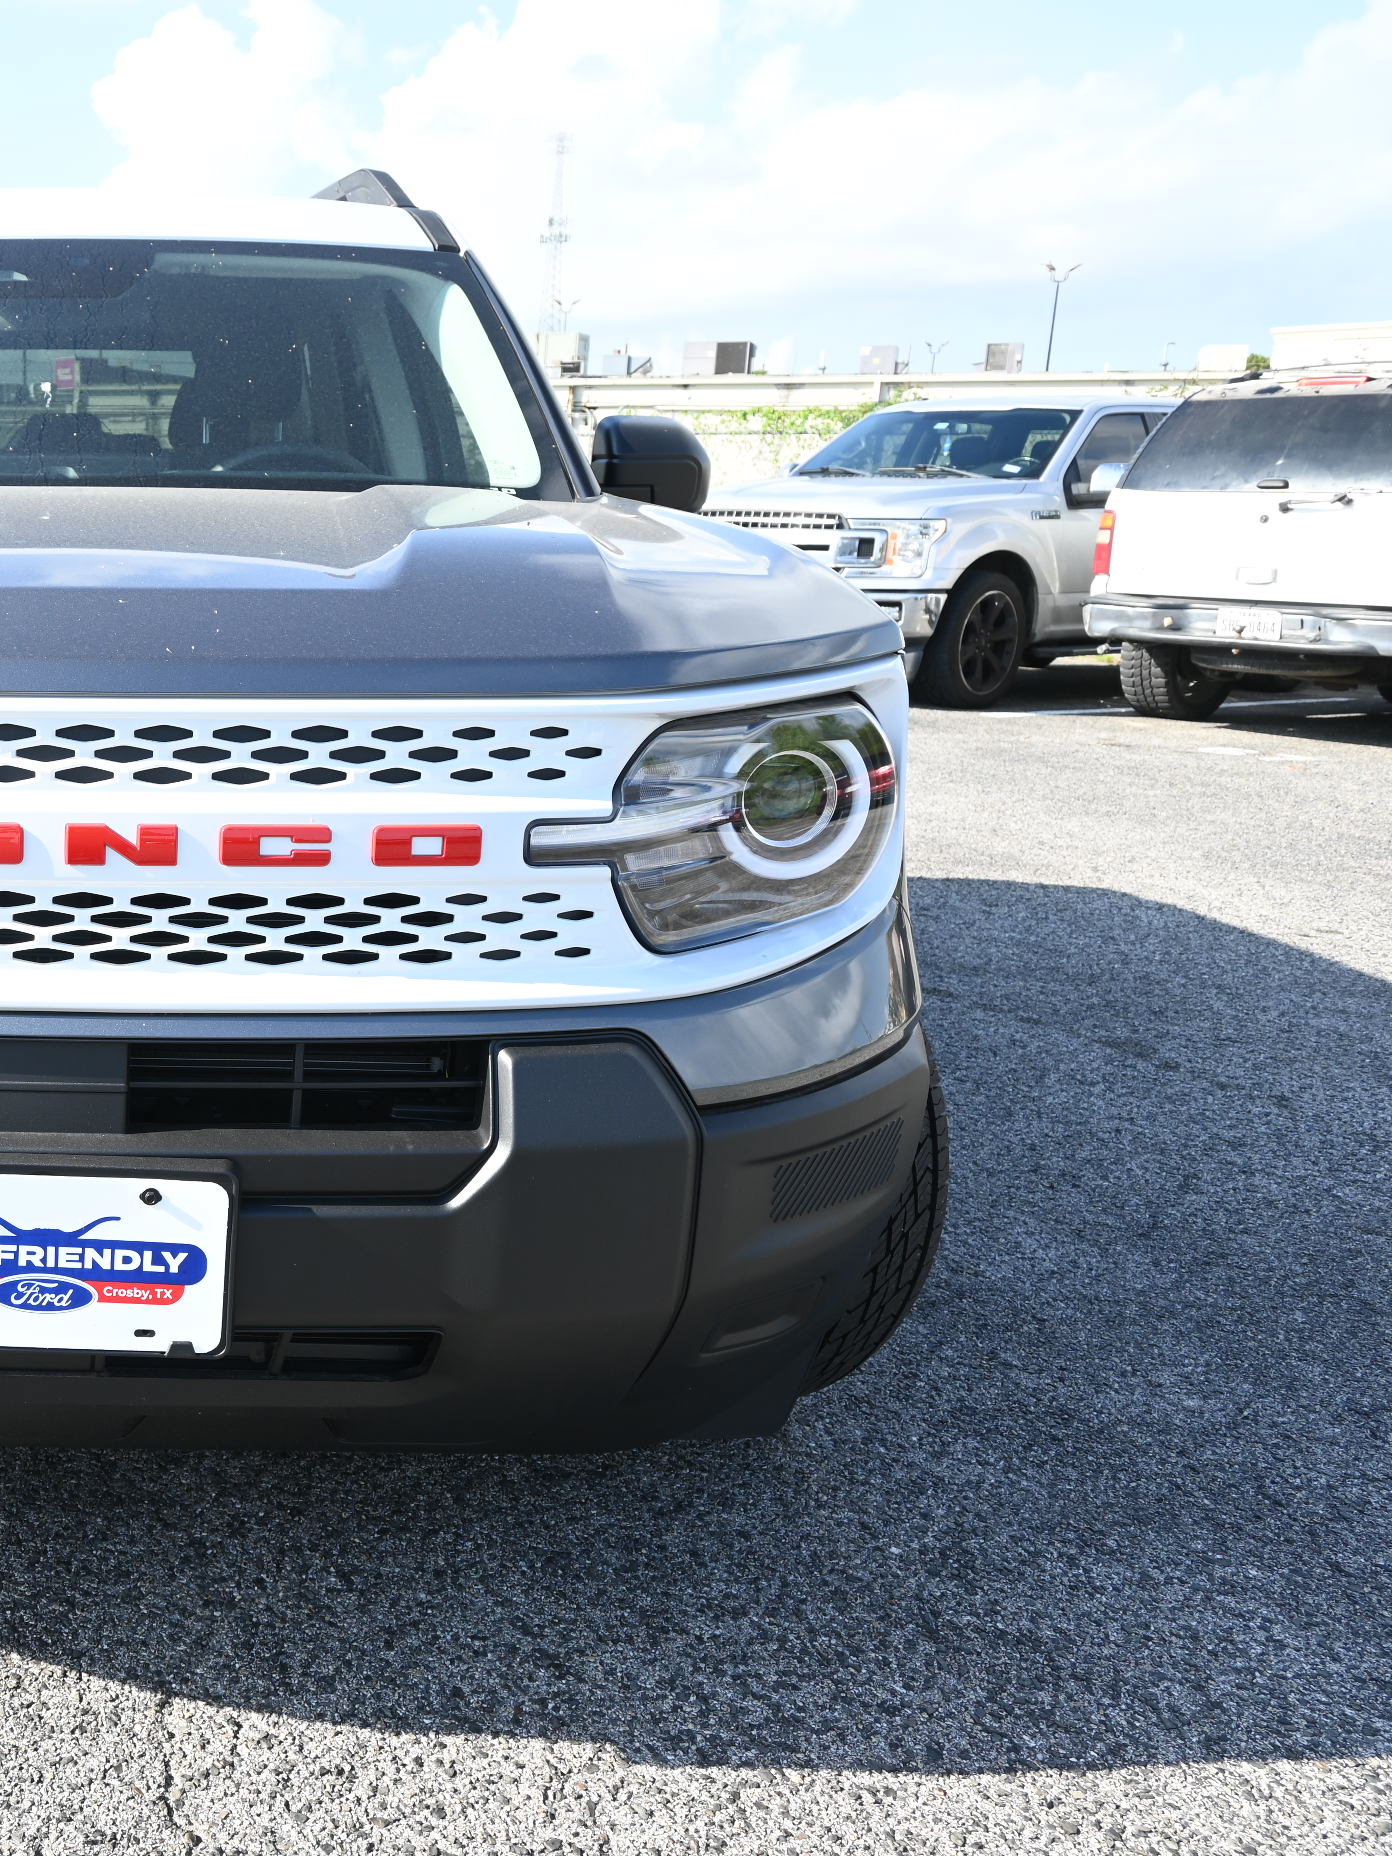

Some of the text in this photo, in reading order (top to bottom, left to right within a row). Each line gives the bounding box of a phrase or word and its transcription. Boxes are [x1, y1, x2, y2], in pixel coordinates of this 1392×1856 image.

[10, 1280, 74, 1308] Ford
[103, 1286, 173, 1300] Crosby, TX
